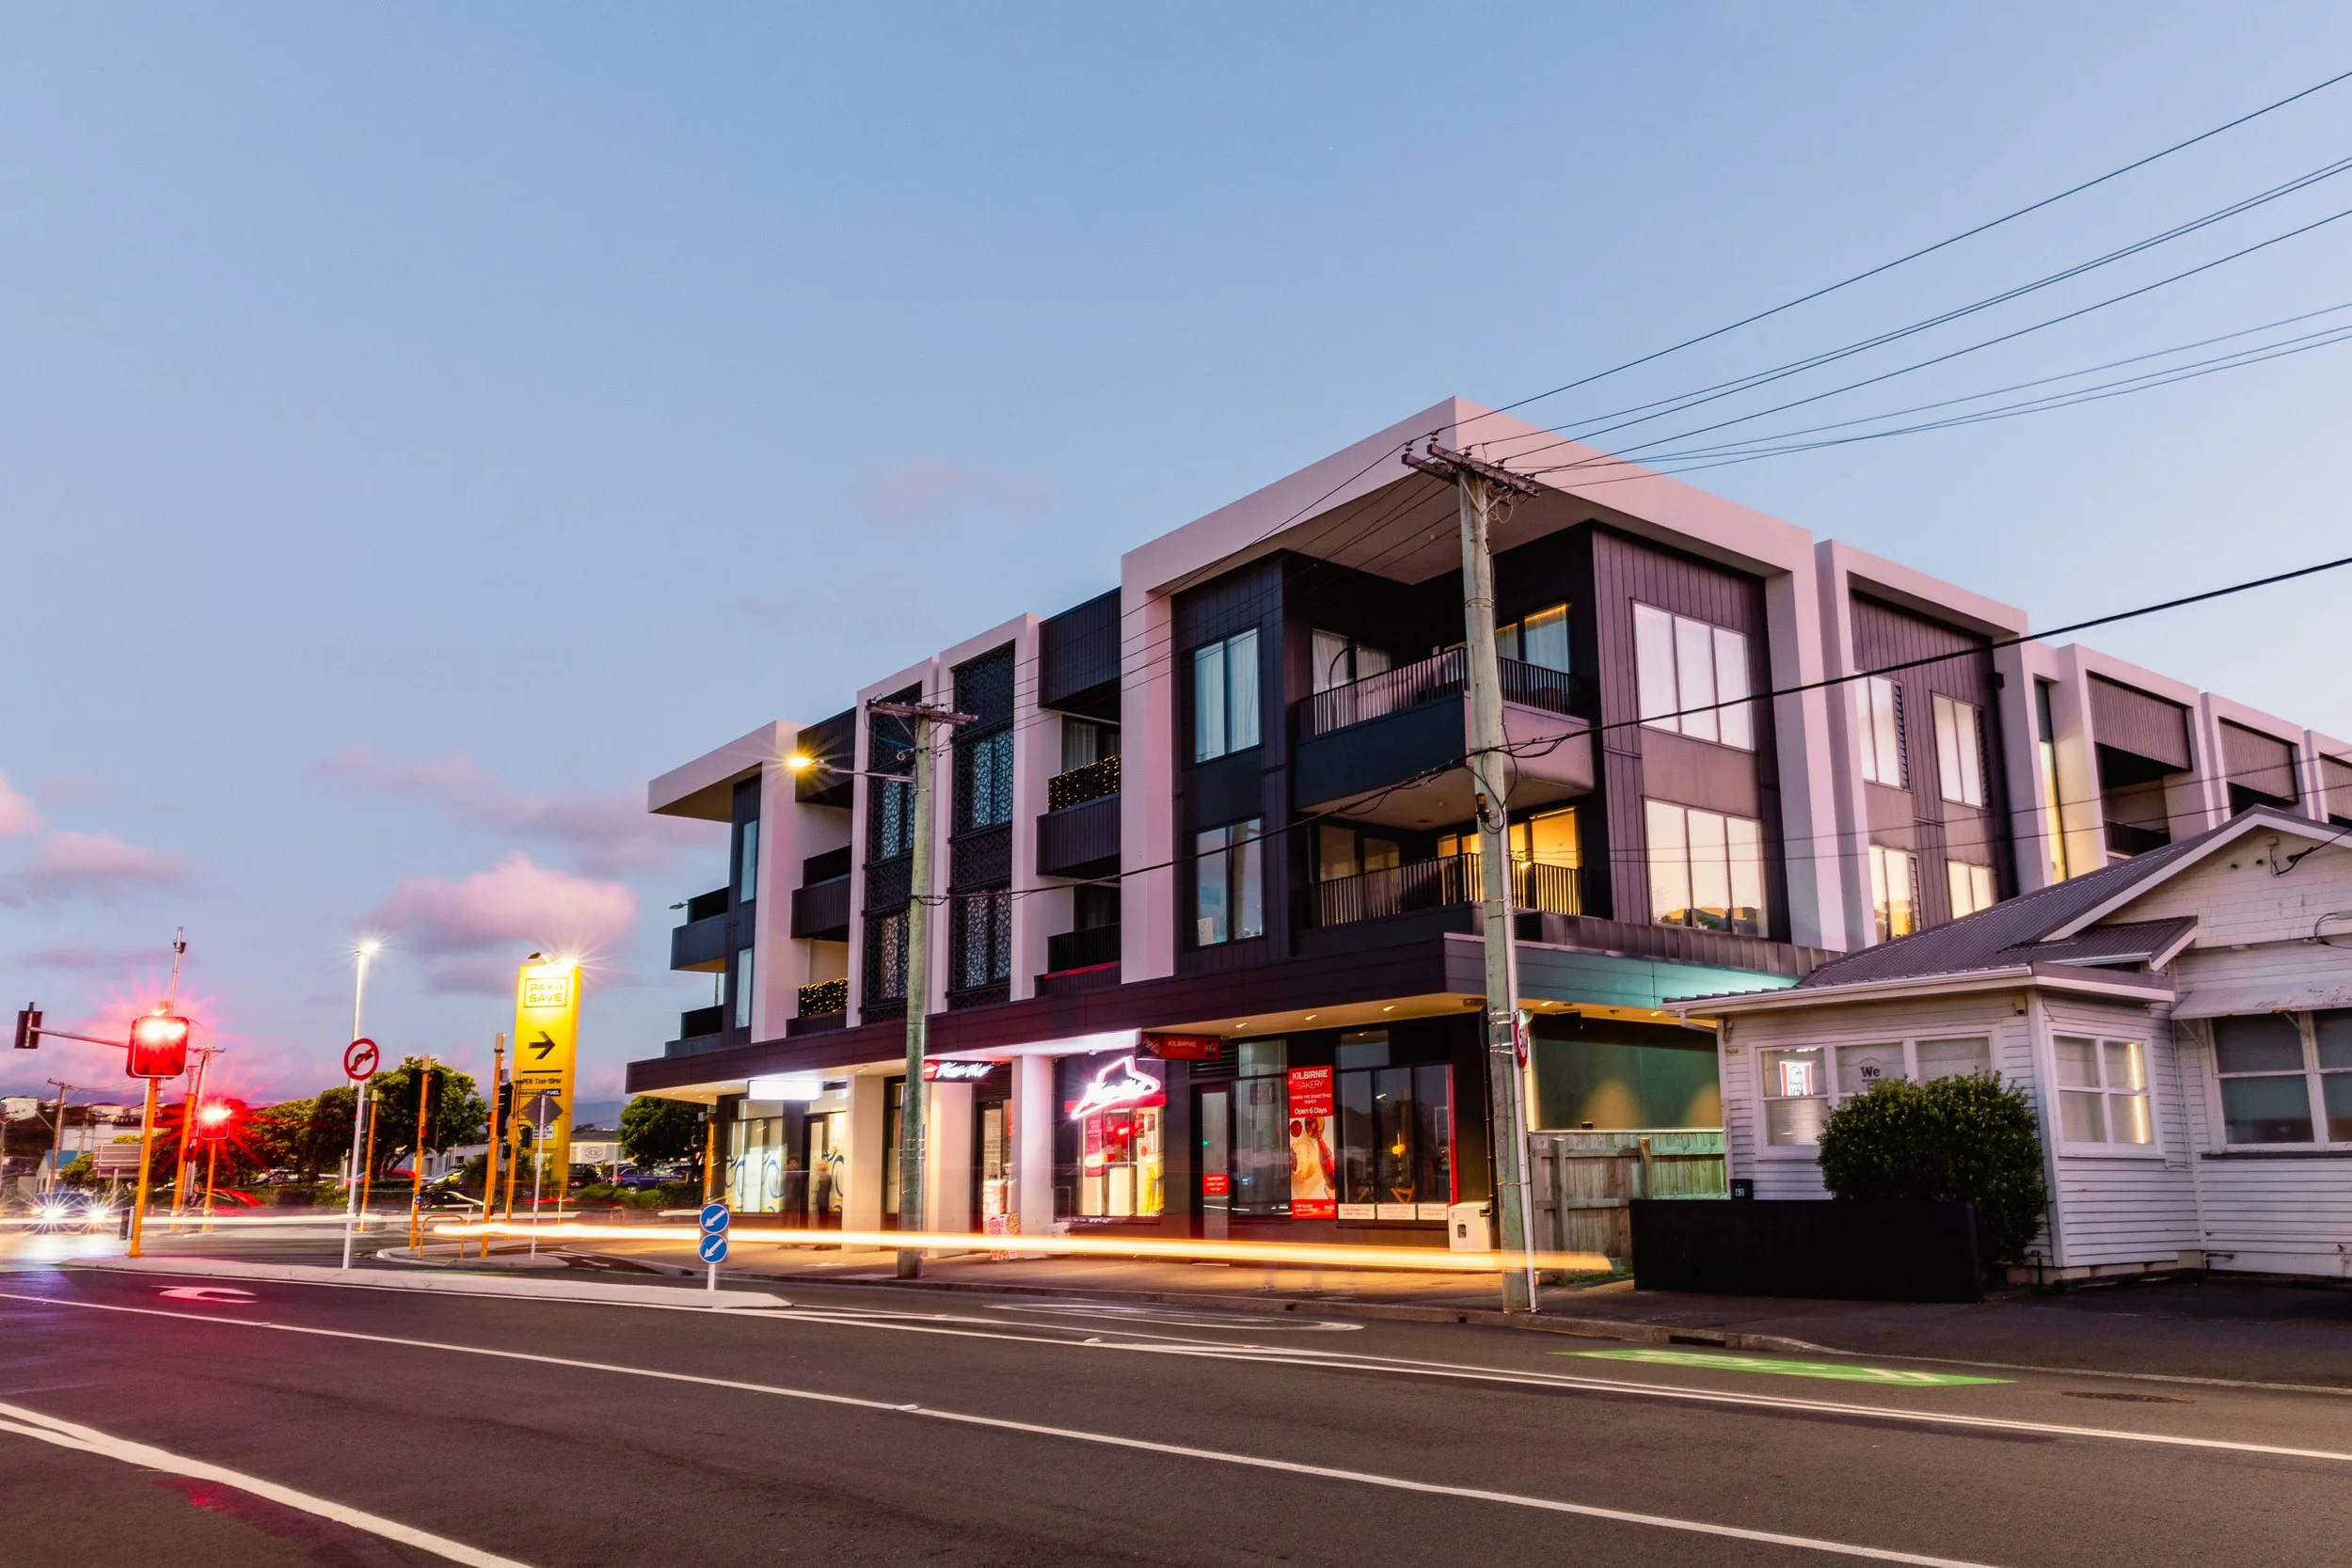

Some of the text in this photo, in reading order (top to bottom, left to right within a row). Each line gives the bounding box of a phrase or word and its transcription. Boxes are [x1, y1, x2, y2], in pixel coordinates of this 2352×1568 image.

[529, 993, 562, 1003] SAVE
[1292, 1069, 1328, 1080] KILBIRNIE
[1860, 1066, 1881, 1077] We
[1296, 1080, 1324, 1090] BAKERY
